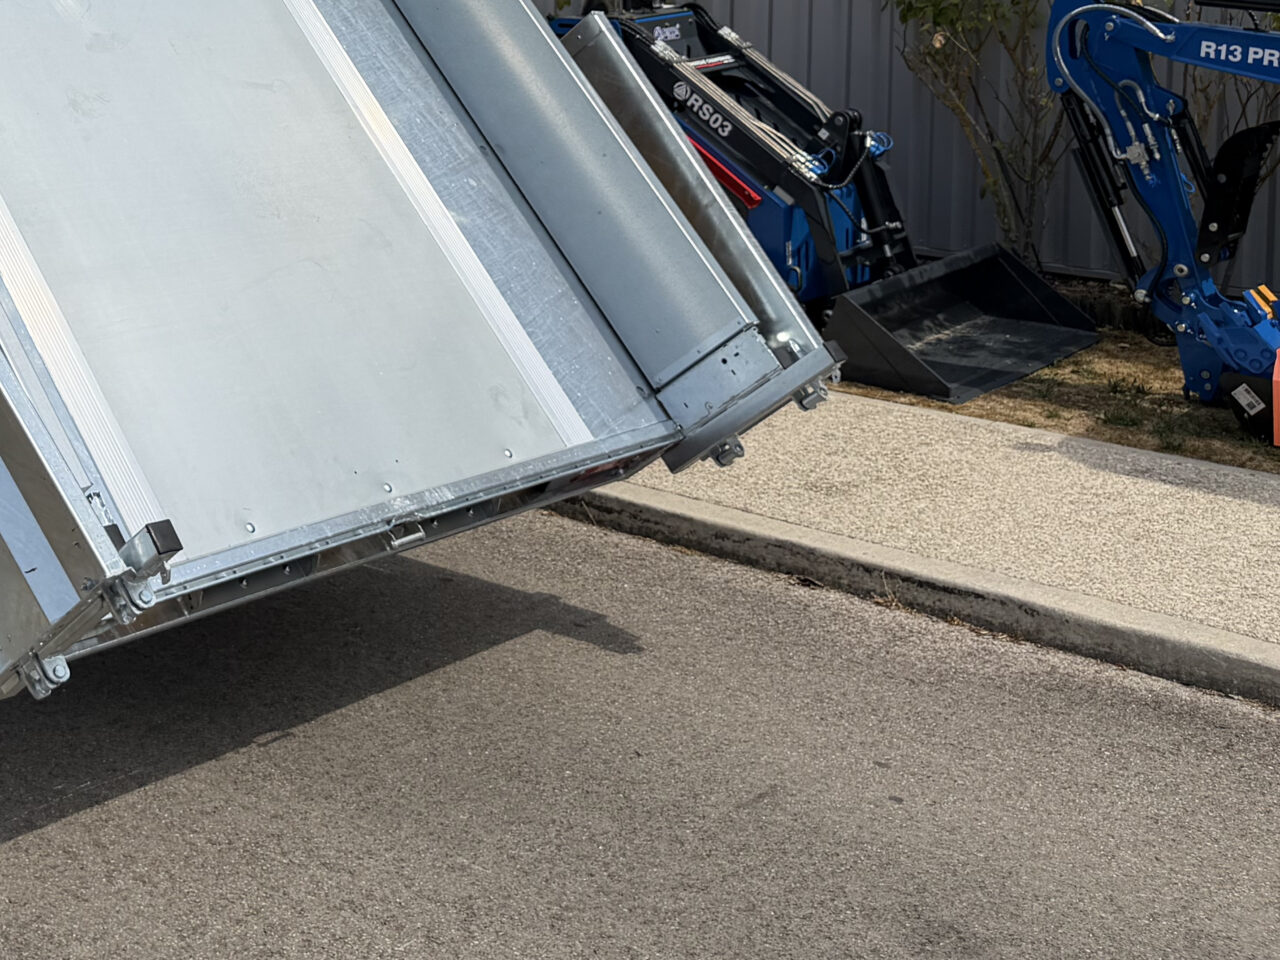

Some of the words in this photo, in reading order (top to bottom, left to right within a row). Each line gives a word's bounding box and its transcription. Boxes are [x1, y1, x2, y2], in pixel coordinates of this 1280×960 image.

[1200, 40, 1242, 63] R13
[1247, 46, 1280, 68] PR
[686, 93, 733, 137] RS03
